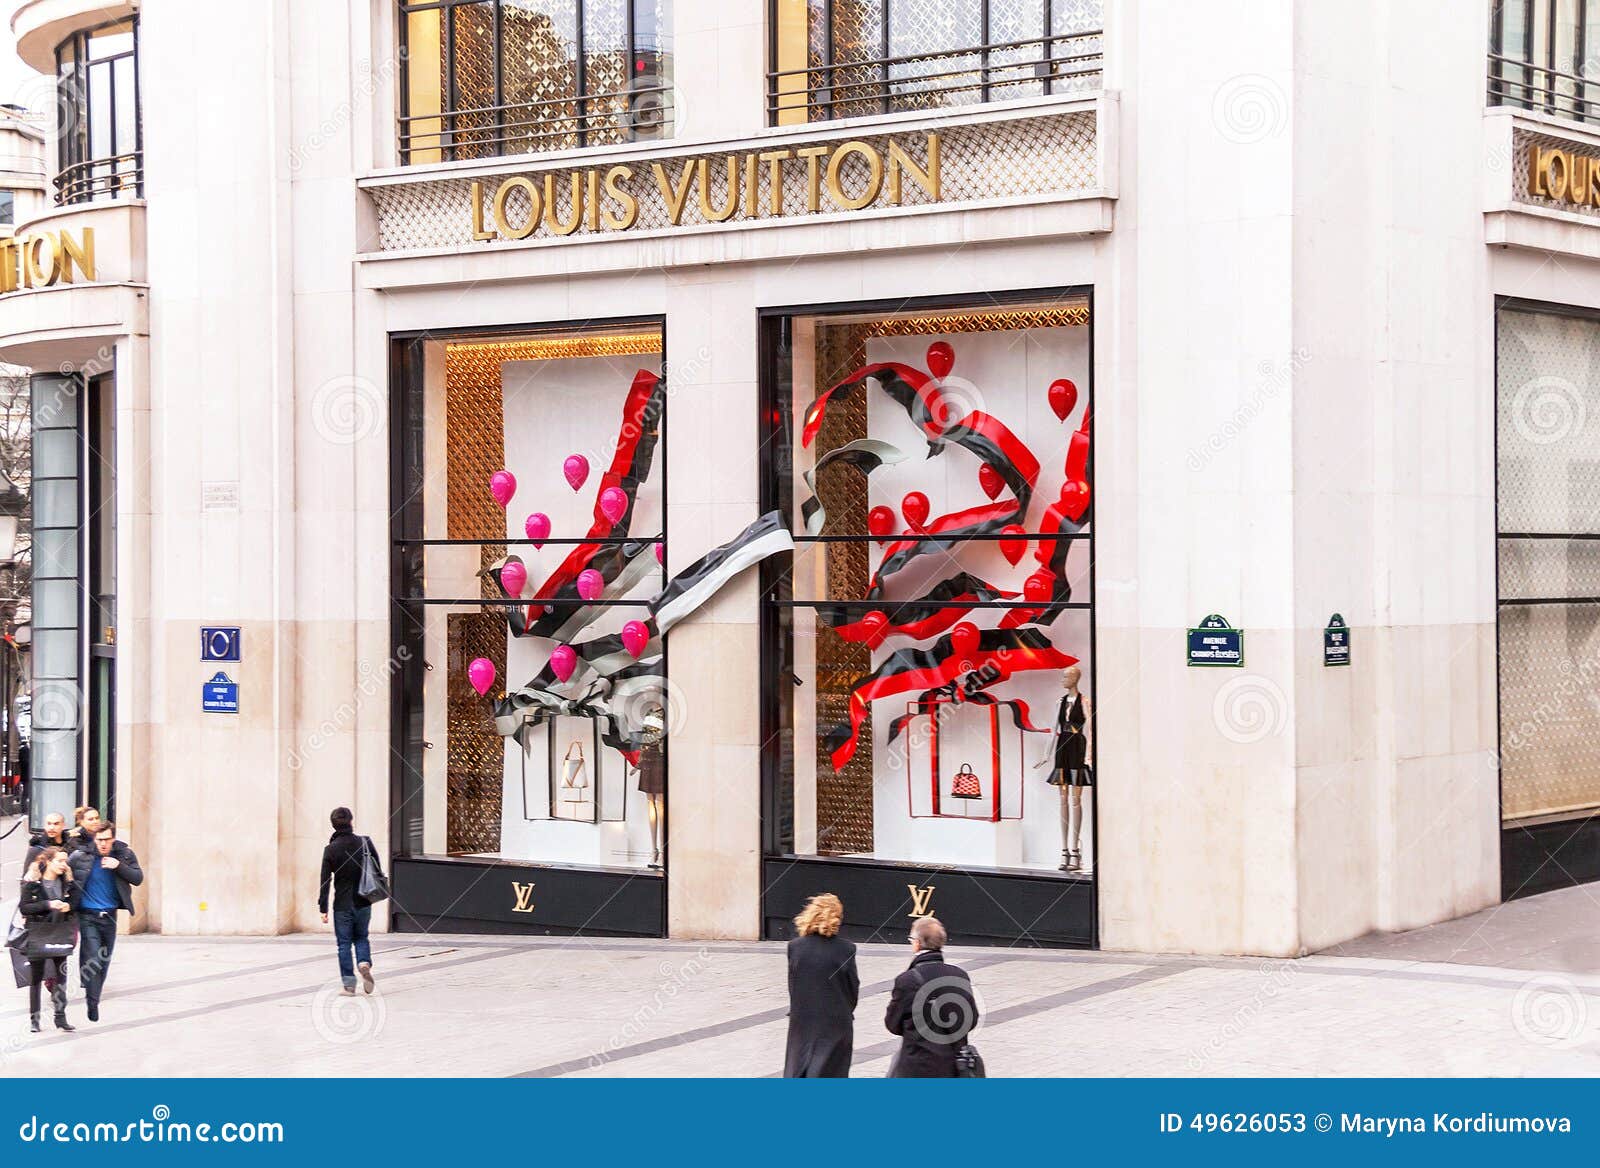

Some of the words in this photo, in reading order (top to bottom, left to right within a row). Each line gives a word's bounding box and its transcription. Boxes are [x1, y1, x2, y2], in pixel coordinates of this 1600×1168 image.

[472, 165, 640, 242] LOUIS
[652, 134, 940, 226] VUITTON
[0, 227, 95, 293] TTON
[203, 630, 237, 658] 101
